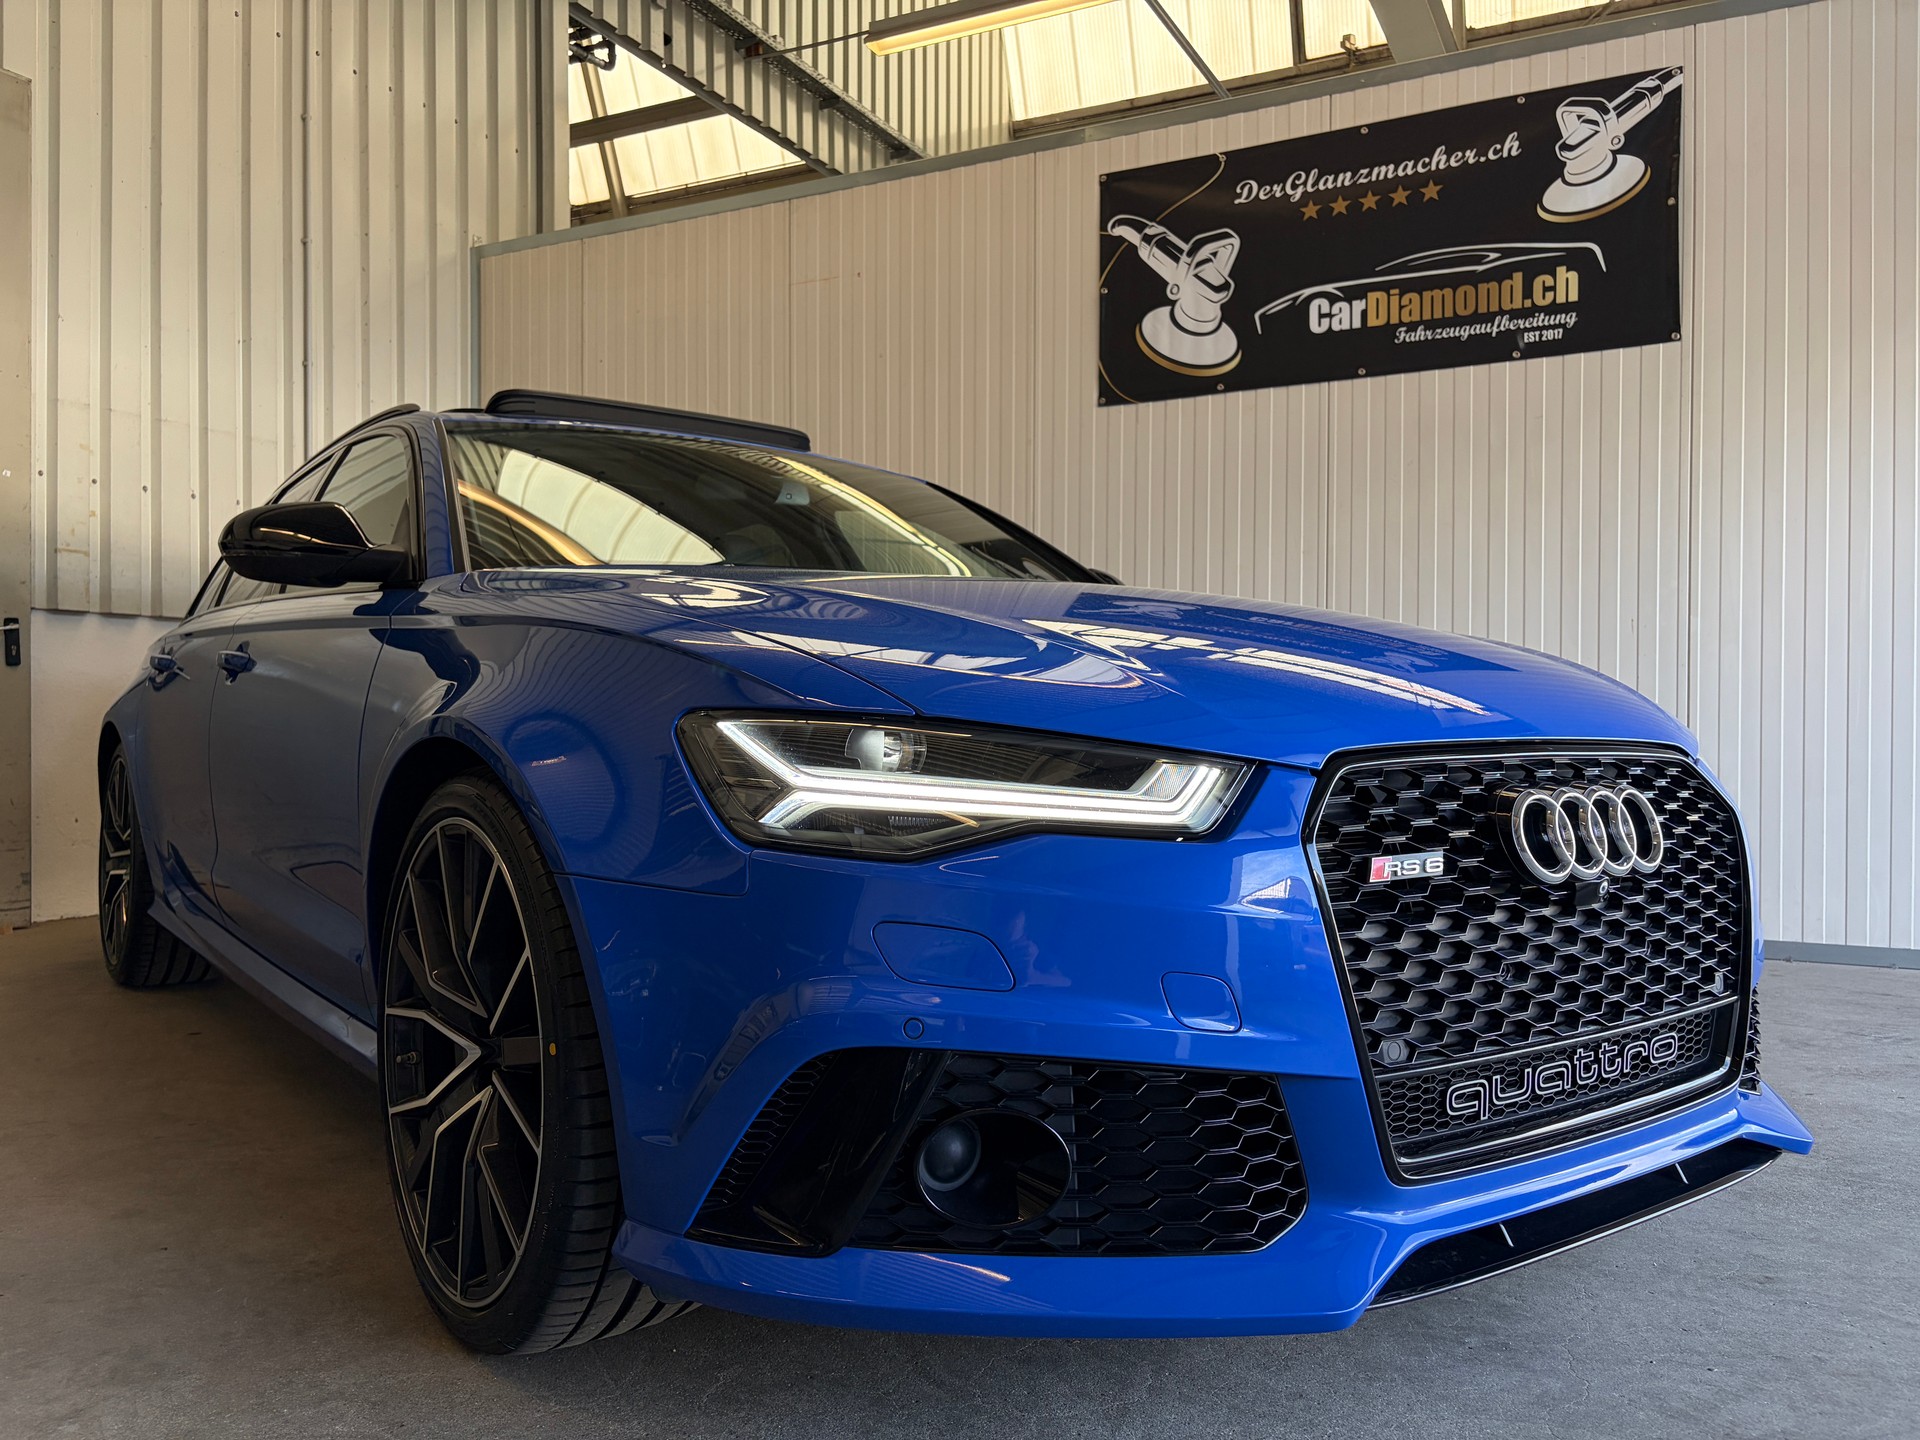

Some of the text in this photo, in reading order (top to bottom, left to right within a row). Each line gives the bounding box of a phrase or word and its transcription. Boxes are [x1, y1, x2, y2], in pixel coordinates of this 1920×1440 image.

[1234, 131, 1522, 205] DerGlanzmacher.ch
[1308, 265, 1579, 334] CarDiamond.ch
[1394, 311, 1578, 344] Fahrzeugaufbereitung
[1523, 328, 1564, 344] EST 2017
[1446, 1032, 1679, 1120] quattro
